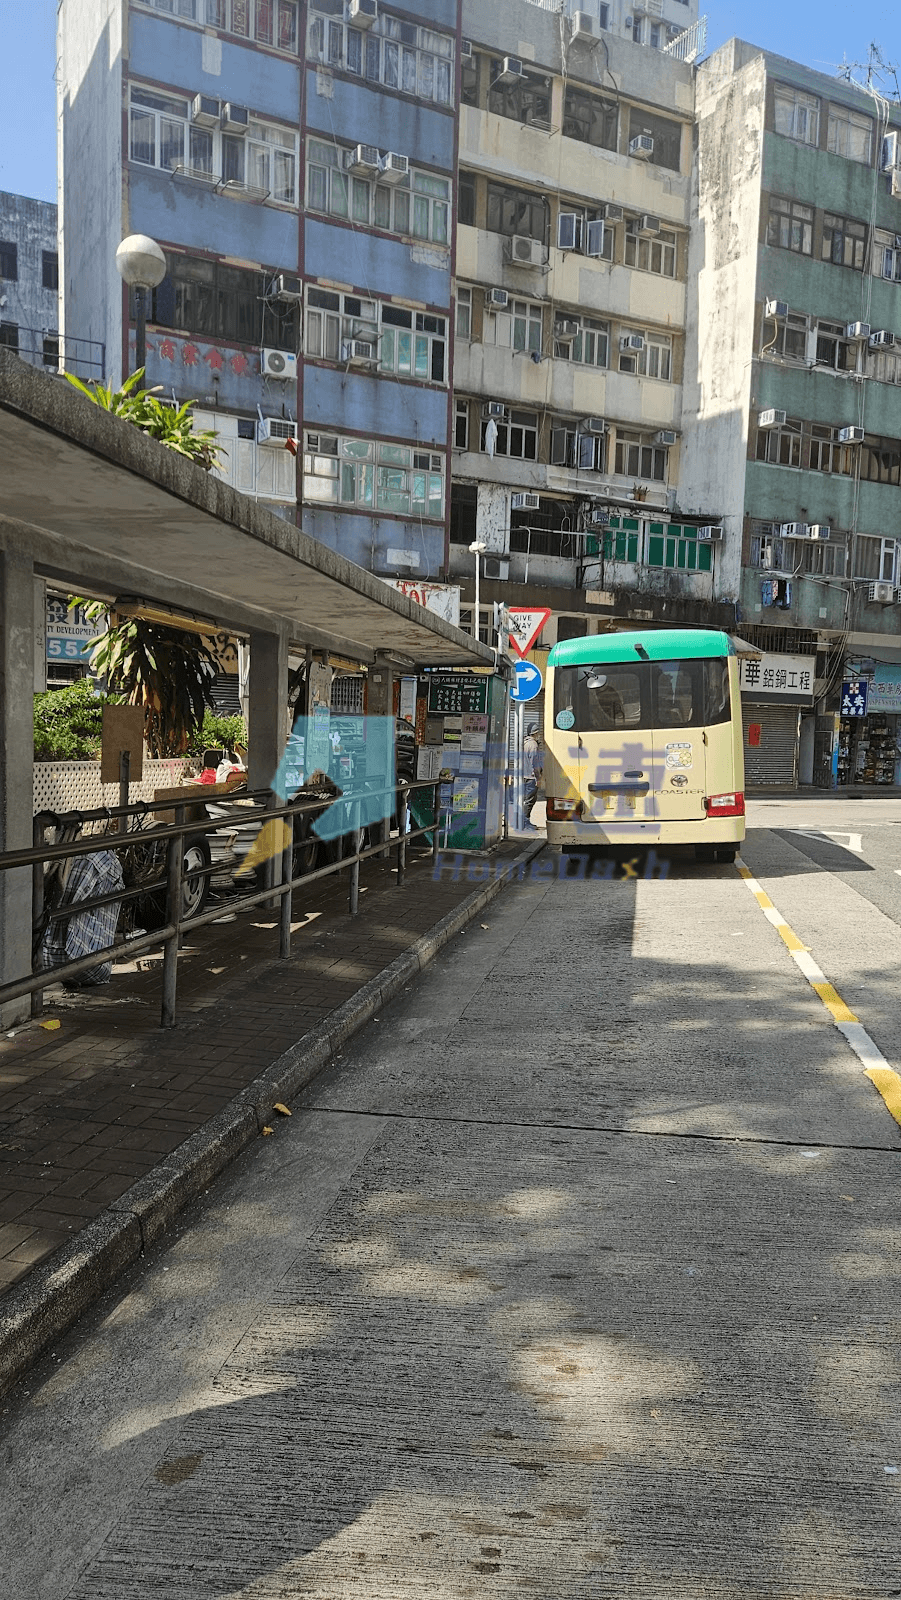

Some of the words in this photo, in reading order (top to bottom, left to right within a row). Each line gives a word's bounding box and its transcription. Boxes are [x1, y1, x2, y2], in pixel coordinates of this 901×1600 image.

[513, 614, 533, 622] GIVE
[56, 626, 100, 636] DEVELOPMENT
[48, 640, 82, 657] 55
[842, 694, 865, 706] 太安
[654, 788, 705, 796] COASTER
